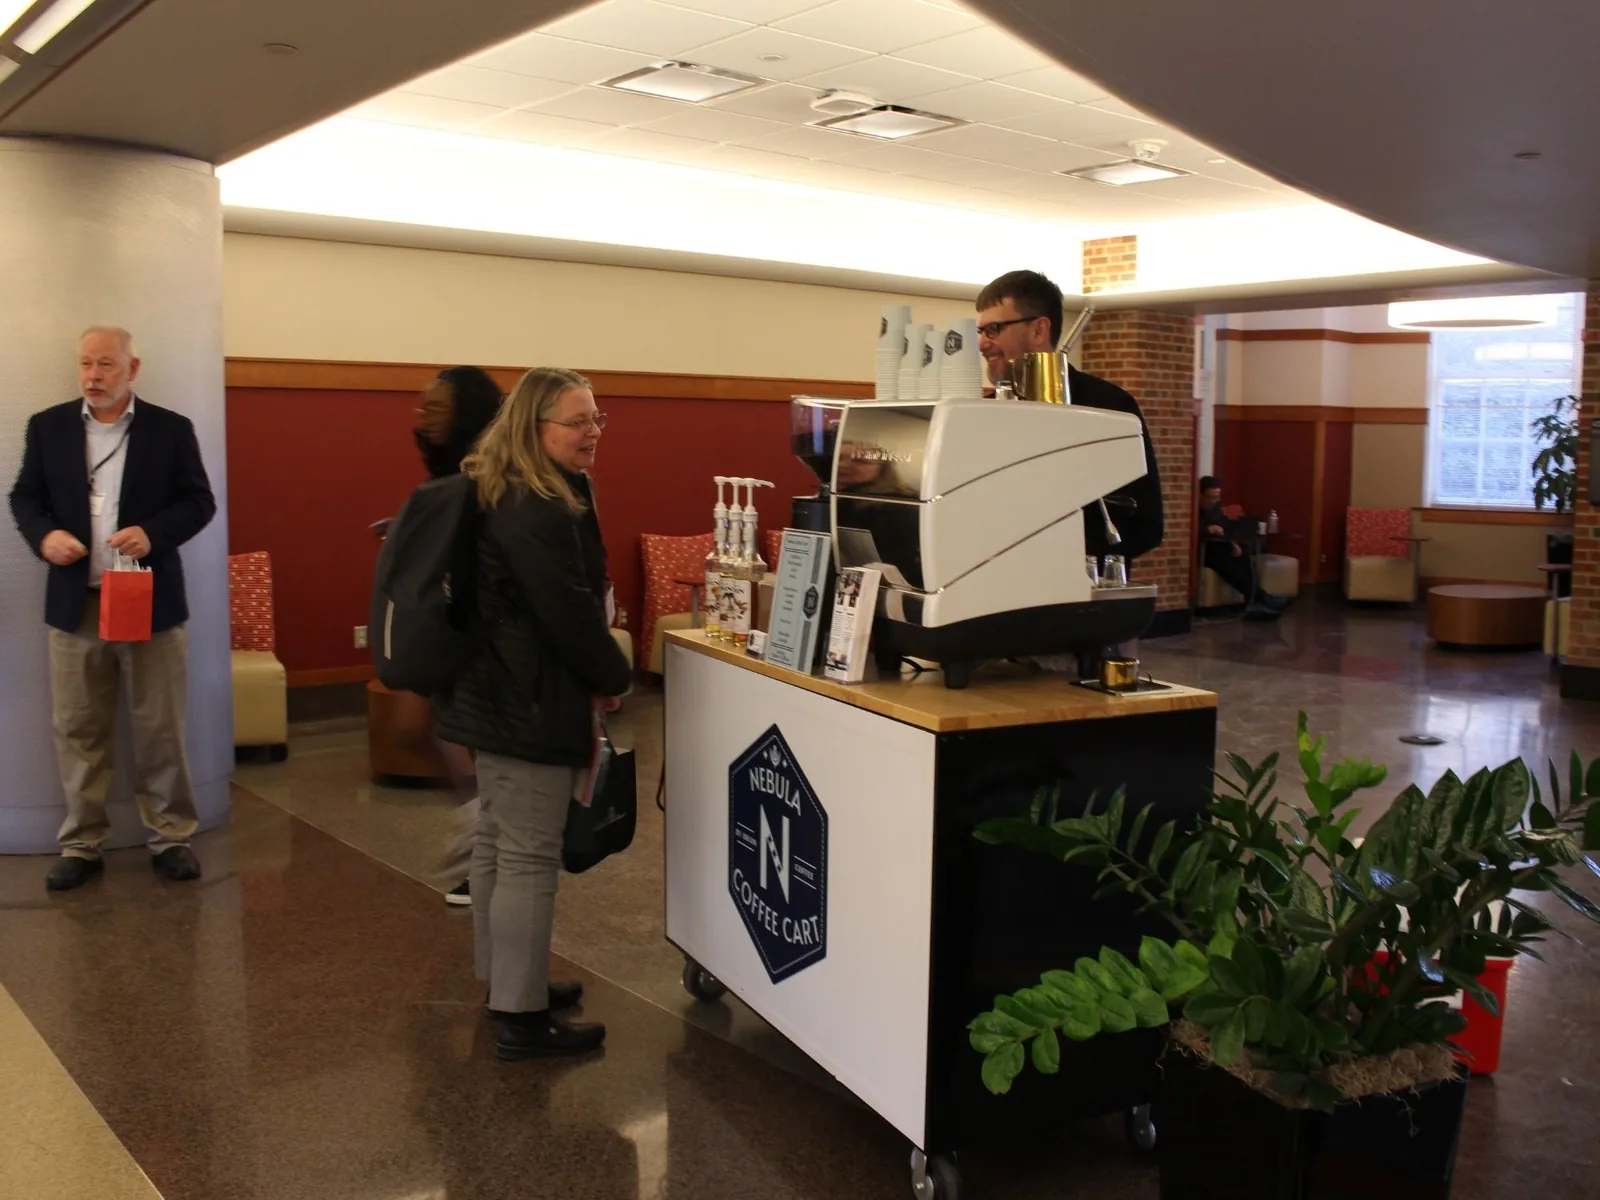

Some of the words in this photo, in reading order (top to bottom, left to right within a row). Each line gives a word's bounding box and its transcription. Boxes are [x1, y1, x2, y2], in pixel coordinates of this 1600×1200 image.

[749, 767, 801, 816] NEBULA
[760, 804, 790, 904] N
[733, 868, 779, 935] COFFEE
[783, 916, 819, 945] CART
